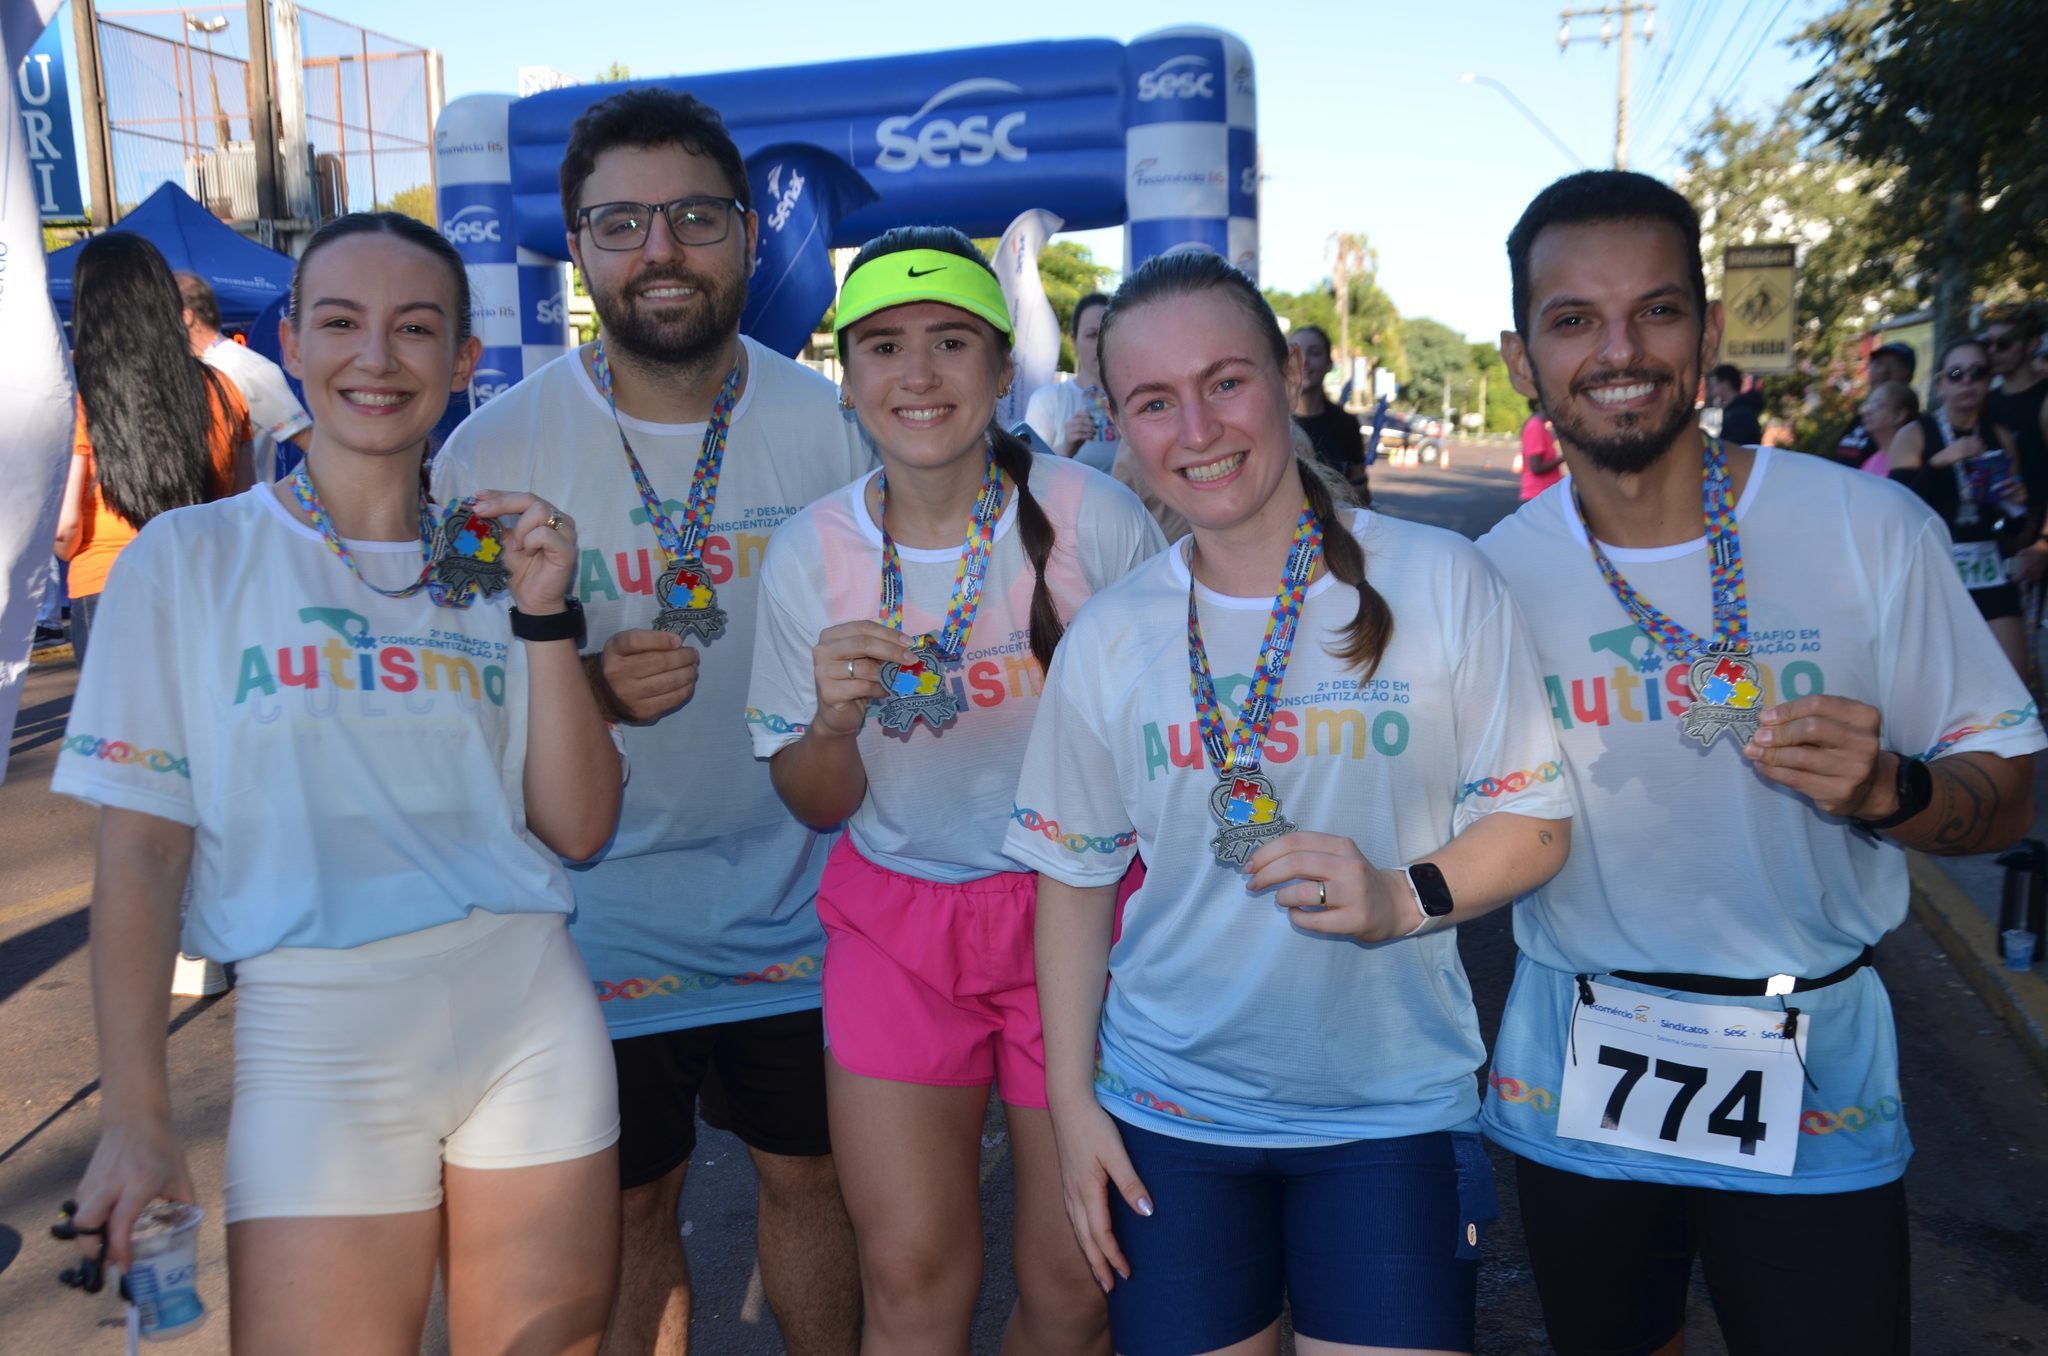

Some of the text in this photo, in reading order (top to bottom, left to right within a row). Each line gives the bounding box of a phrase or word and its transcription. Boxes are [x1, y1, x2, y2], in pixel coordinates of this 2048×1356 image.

[1747, 629, 1820, 641] ESAFIO EM
[1801, 642, 1821, 652] AO
[233, 637, 505, 707] Autismo
[1393, 681, 1410, 691] EM
[1276, 690, 1410, 707] ONSCIENTIZAÇÃO AO
[1635, 1012, 1648, 1022] RS
[1660, 1020, 1709, 1035] Sindicatos
[1723, 1028, 1747, 1038] Sesc
[1761, 1030, 1787, 1040] Sena
[1598, 1044, 1767, 1156] 774
